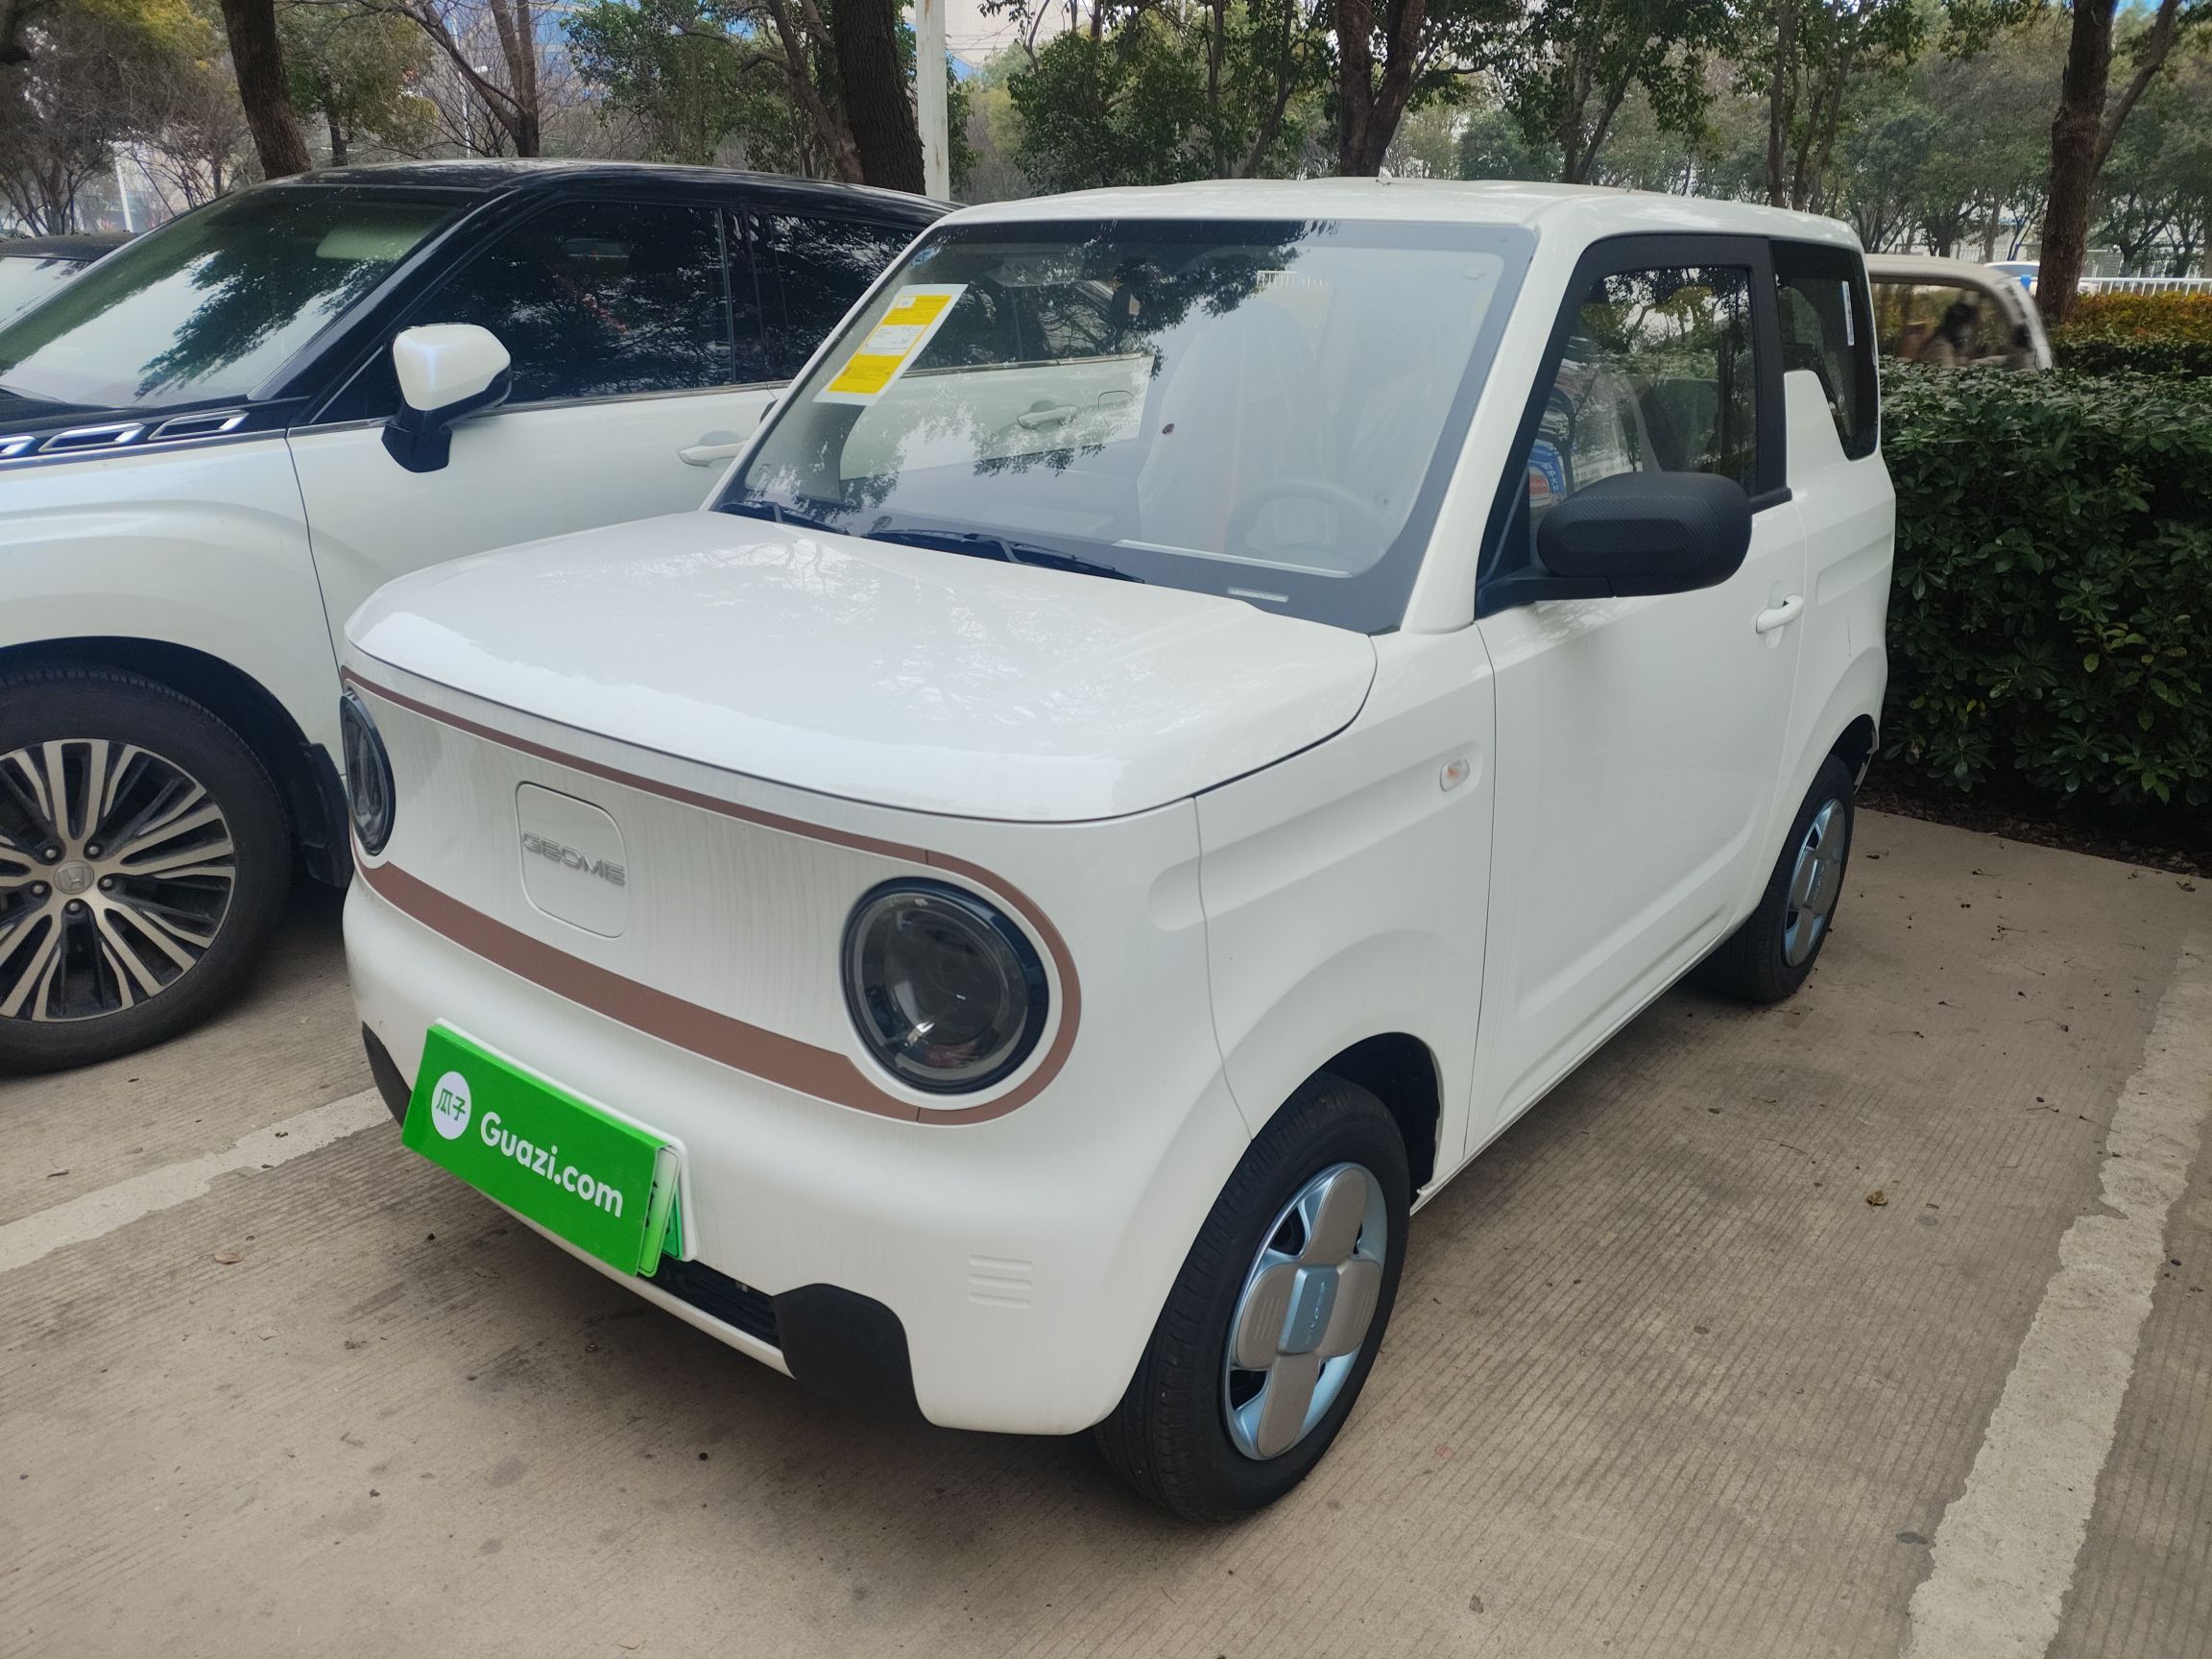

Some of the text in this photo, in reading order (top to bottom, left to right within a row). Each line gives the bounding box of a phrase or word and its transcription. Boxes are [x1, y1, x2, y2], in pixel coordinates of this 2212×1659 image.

[522, 831, 626, 886] GEOME
[436, 1088, 466, 1121] 瓜子
[480, 1112, 623, 1218] Guazi.com
